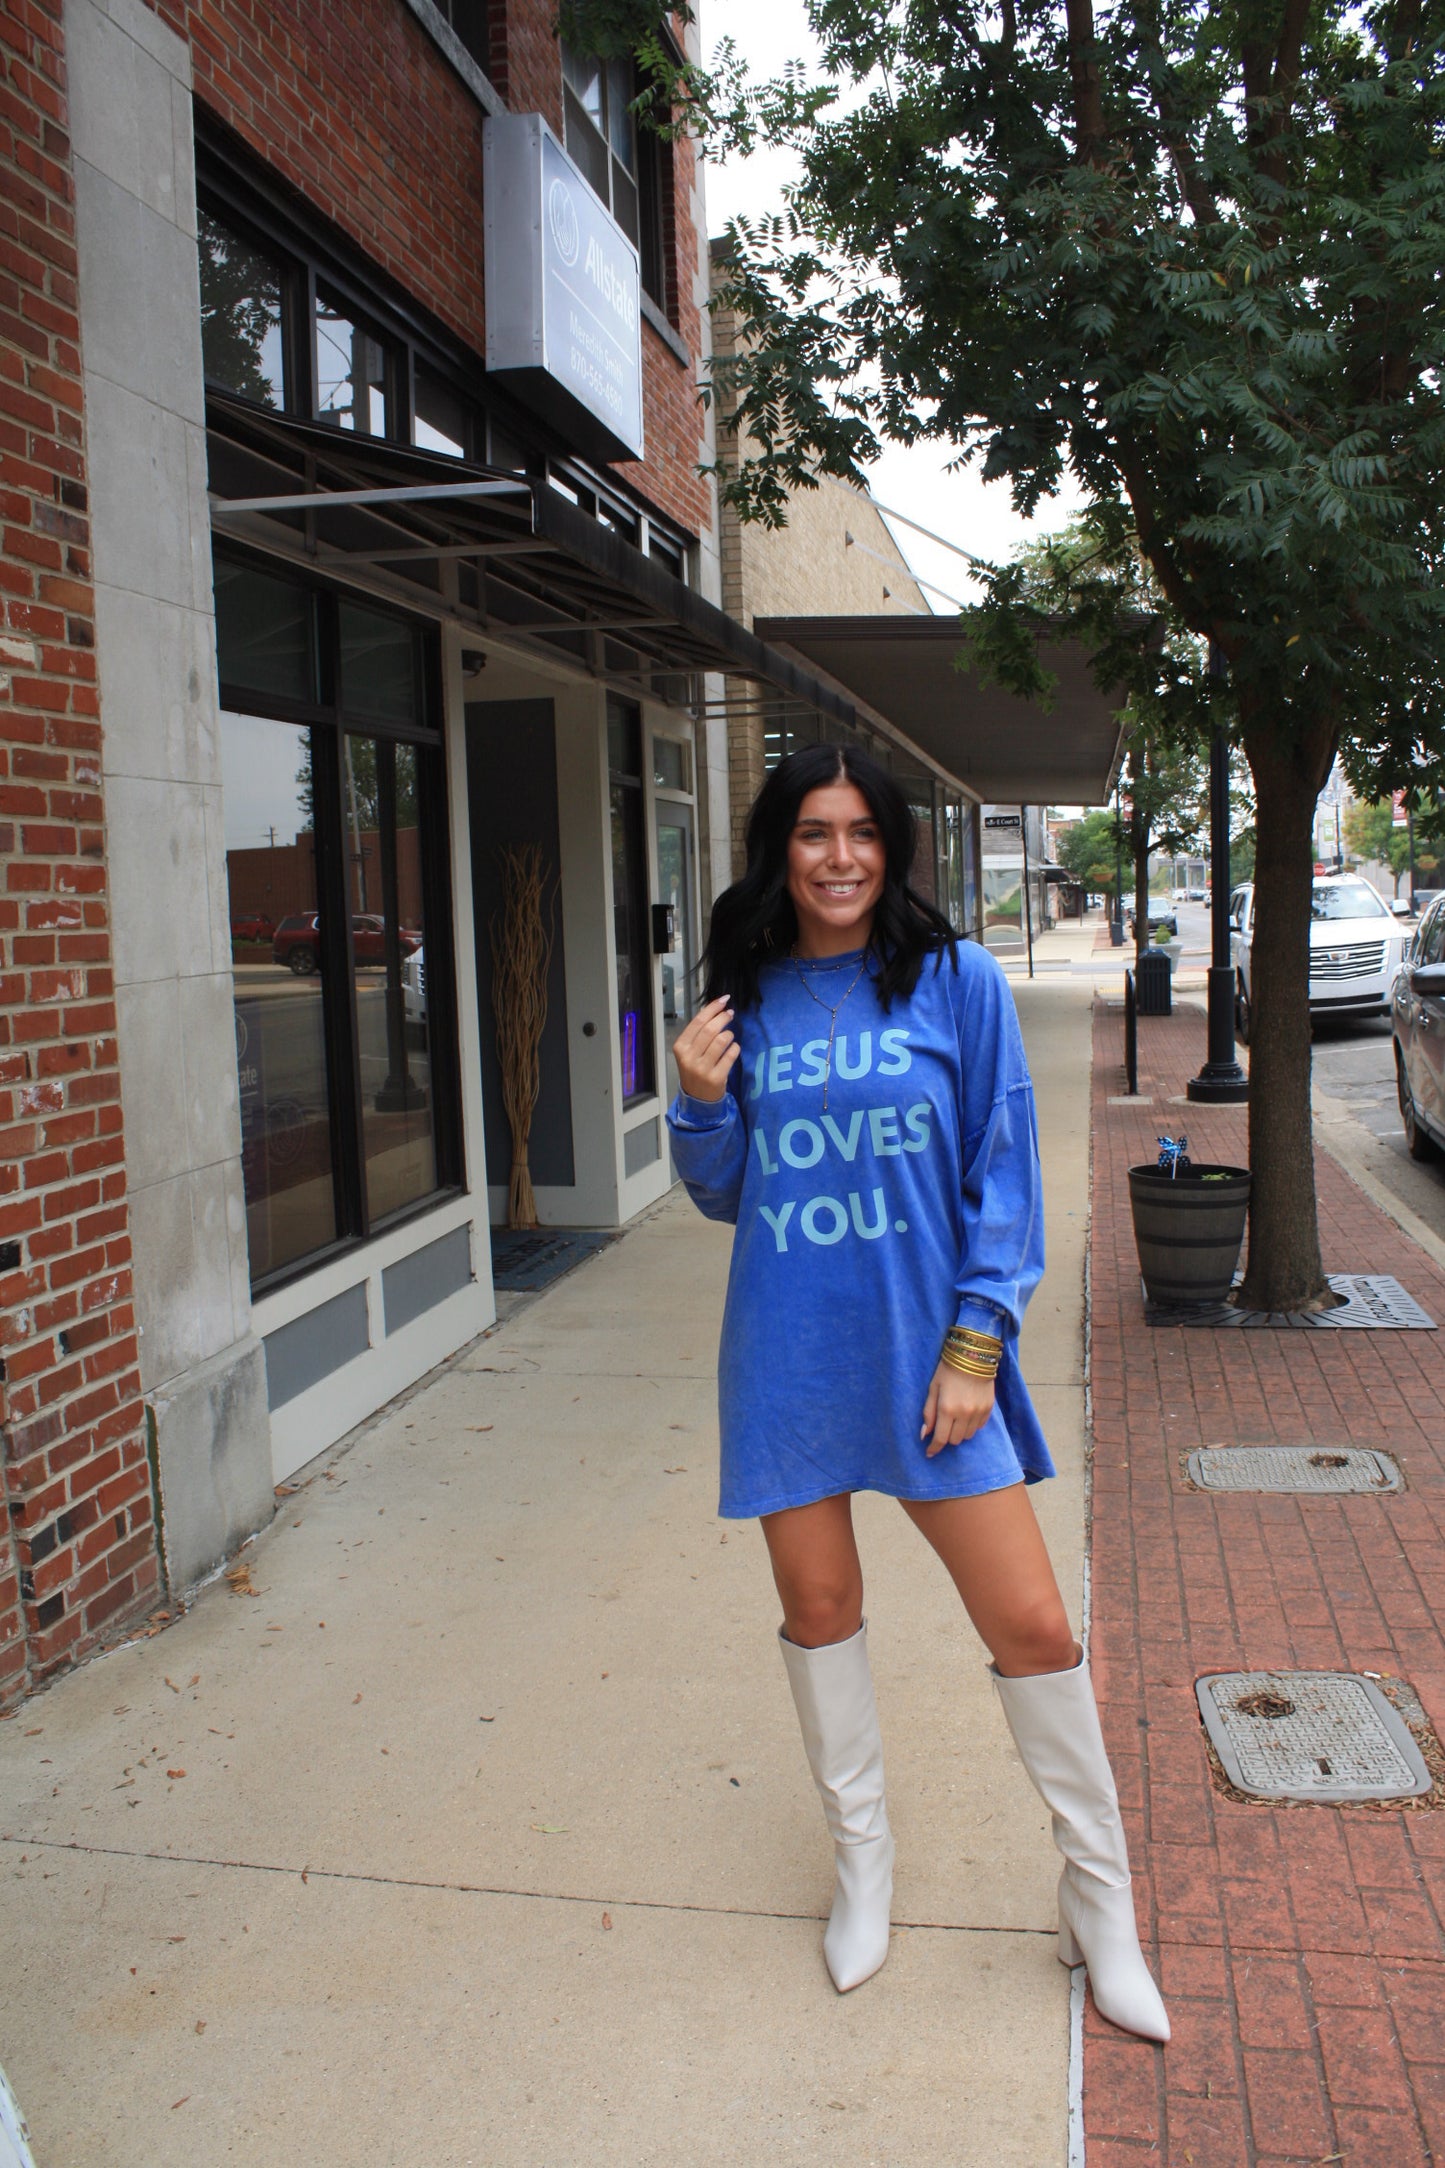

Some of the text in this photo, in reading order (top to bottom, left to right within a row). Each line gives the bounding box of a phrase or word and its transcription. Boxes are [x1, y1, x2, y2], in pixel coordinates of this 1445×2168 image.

[584, 234, 636, 333] Allstate
[604, 348, 624, 389] Smith
[750, 1028, 912, 1100] JESUS
[754, 1103, 933, 1176] LOVES
[758, 1187, 908, 1253] YOU.
